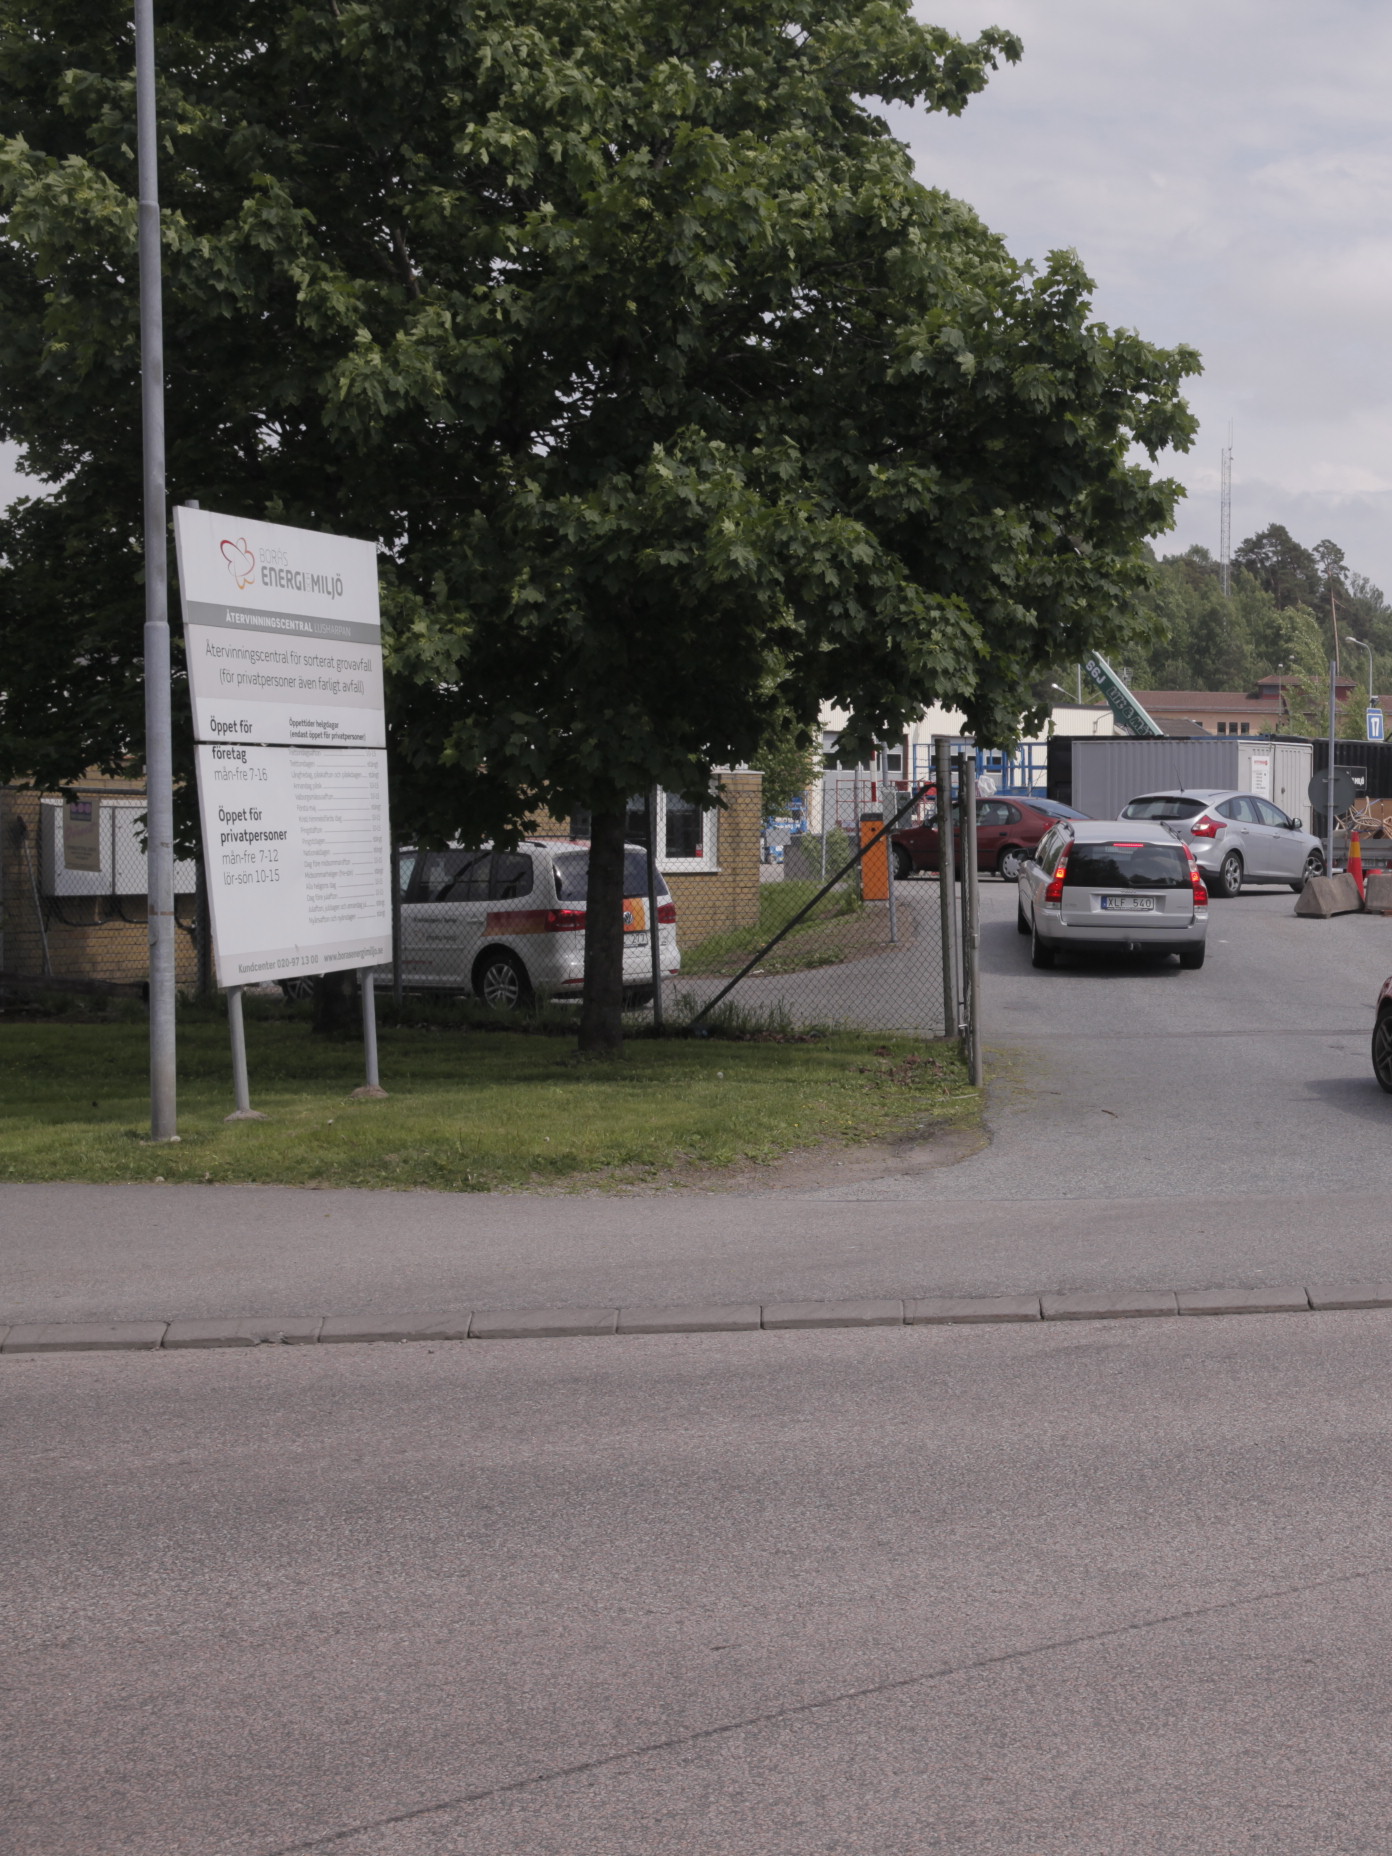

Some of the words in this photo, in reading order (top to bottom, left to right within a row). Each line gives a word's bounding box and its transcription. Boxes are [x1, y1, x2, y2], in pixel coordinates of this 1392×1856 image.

[259, 548, 288, 566] BORÅS
[261, 566, 306, 592] ENERGI
[311, 573, 343, 600] MILJÖ
[226, 609, 313, 632] ÅTERVINNINGSCENTRAL
[206, 639, 289, 664] Återvinningscentral
[290, 651, 301, 665] för
[304, 655, 335, 669] sorterat
[337, 659, 372, 672] grovavfall
[219, 668, 235, 685] (för
[237, 671, 296, 689] privatpersoner
[298, 677, 317, 689] även
[318, 677, 341, 694] farligt
[342, 680, 364, 695] avfall)
[210, 715, 238, 735] Öppet
[240, 720, 252, 734] för
[289, 717, 315, 728] Öppettider
[316, 720, 339, 730] helgdagar
[1371, 717, 1380, 737] 17
[309, 732, 323, 740] öppet
[323, 731, 331, 739] för
[331, 732, 366, 741] privatpersoner)
[212, 745, 247, 763] företag
[214, 766, 248, 781] mån-fre
[250, 768, 268, 781] 7-16
[218, 805, 247, 825] Öppet
[249, 807, 262, 821] för
[220, 828, 287, 847] privatpersoner
[222, 850, 256, 865] mån-fre
[259, 849, 278, 862] 7-12
[223, 871, 254, 885] lör-sön
[256, 869, 280, 883] 10-15
[1108, 898, 1124, 907] XLF
[1133, 898, 1152, 908] 540
[238, 959, 276, 973] Kundcenter
[277, 957, 300, 969] 020-97
[301, 956, 310, 966] 13
[310, 955, 319, 964] 00
